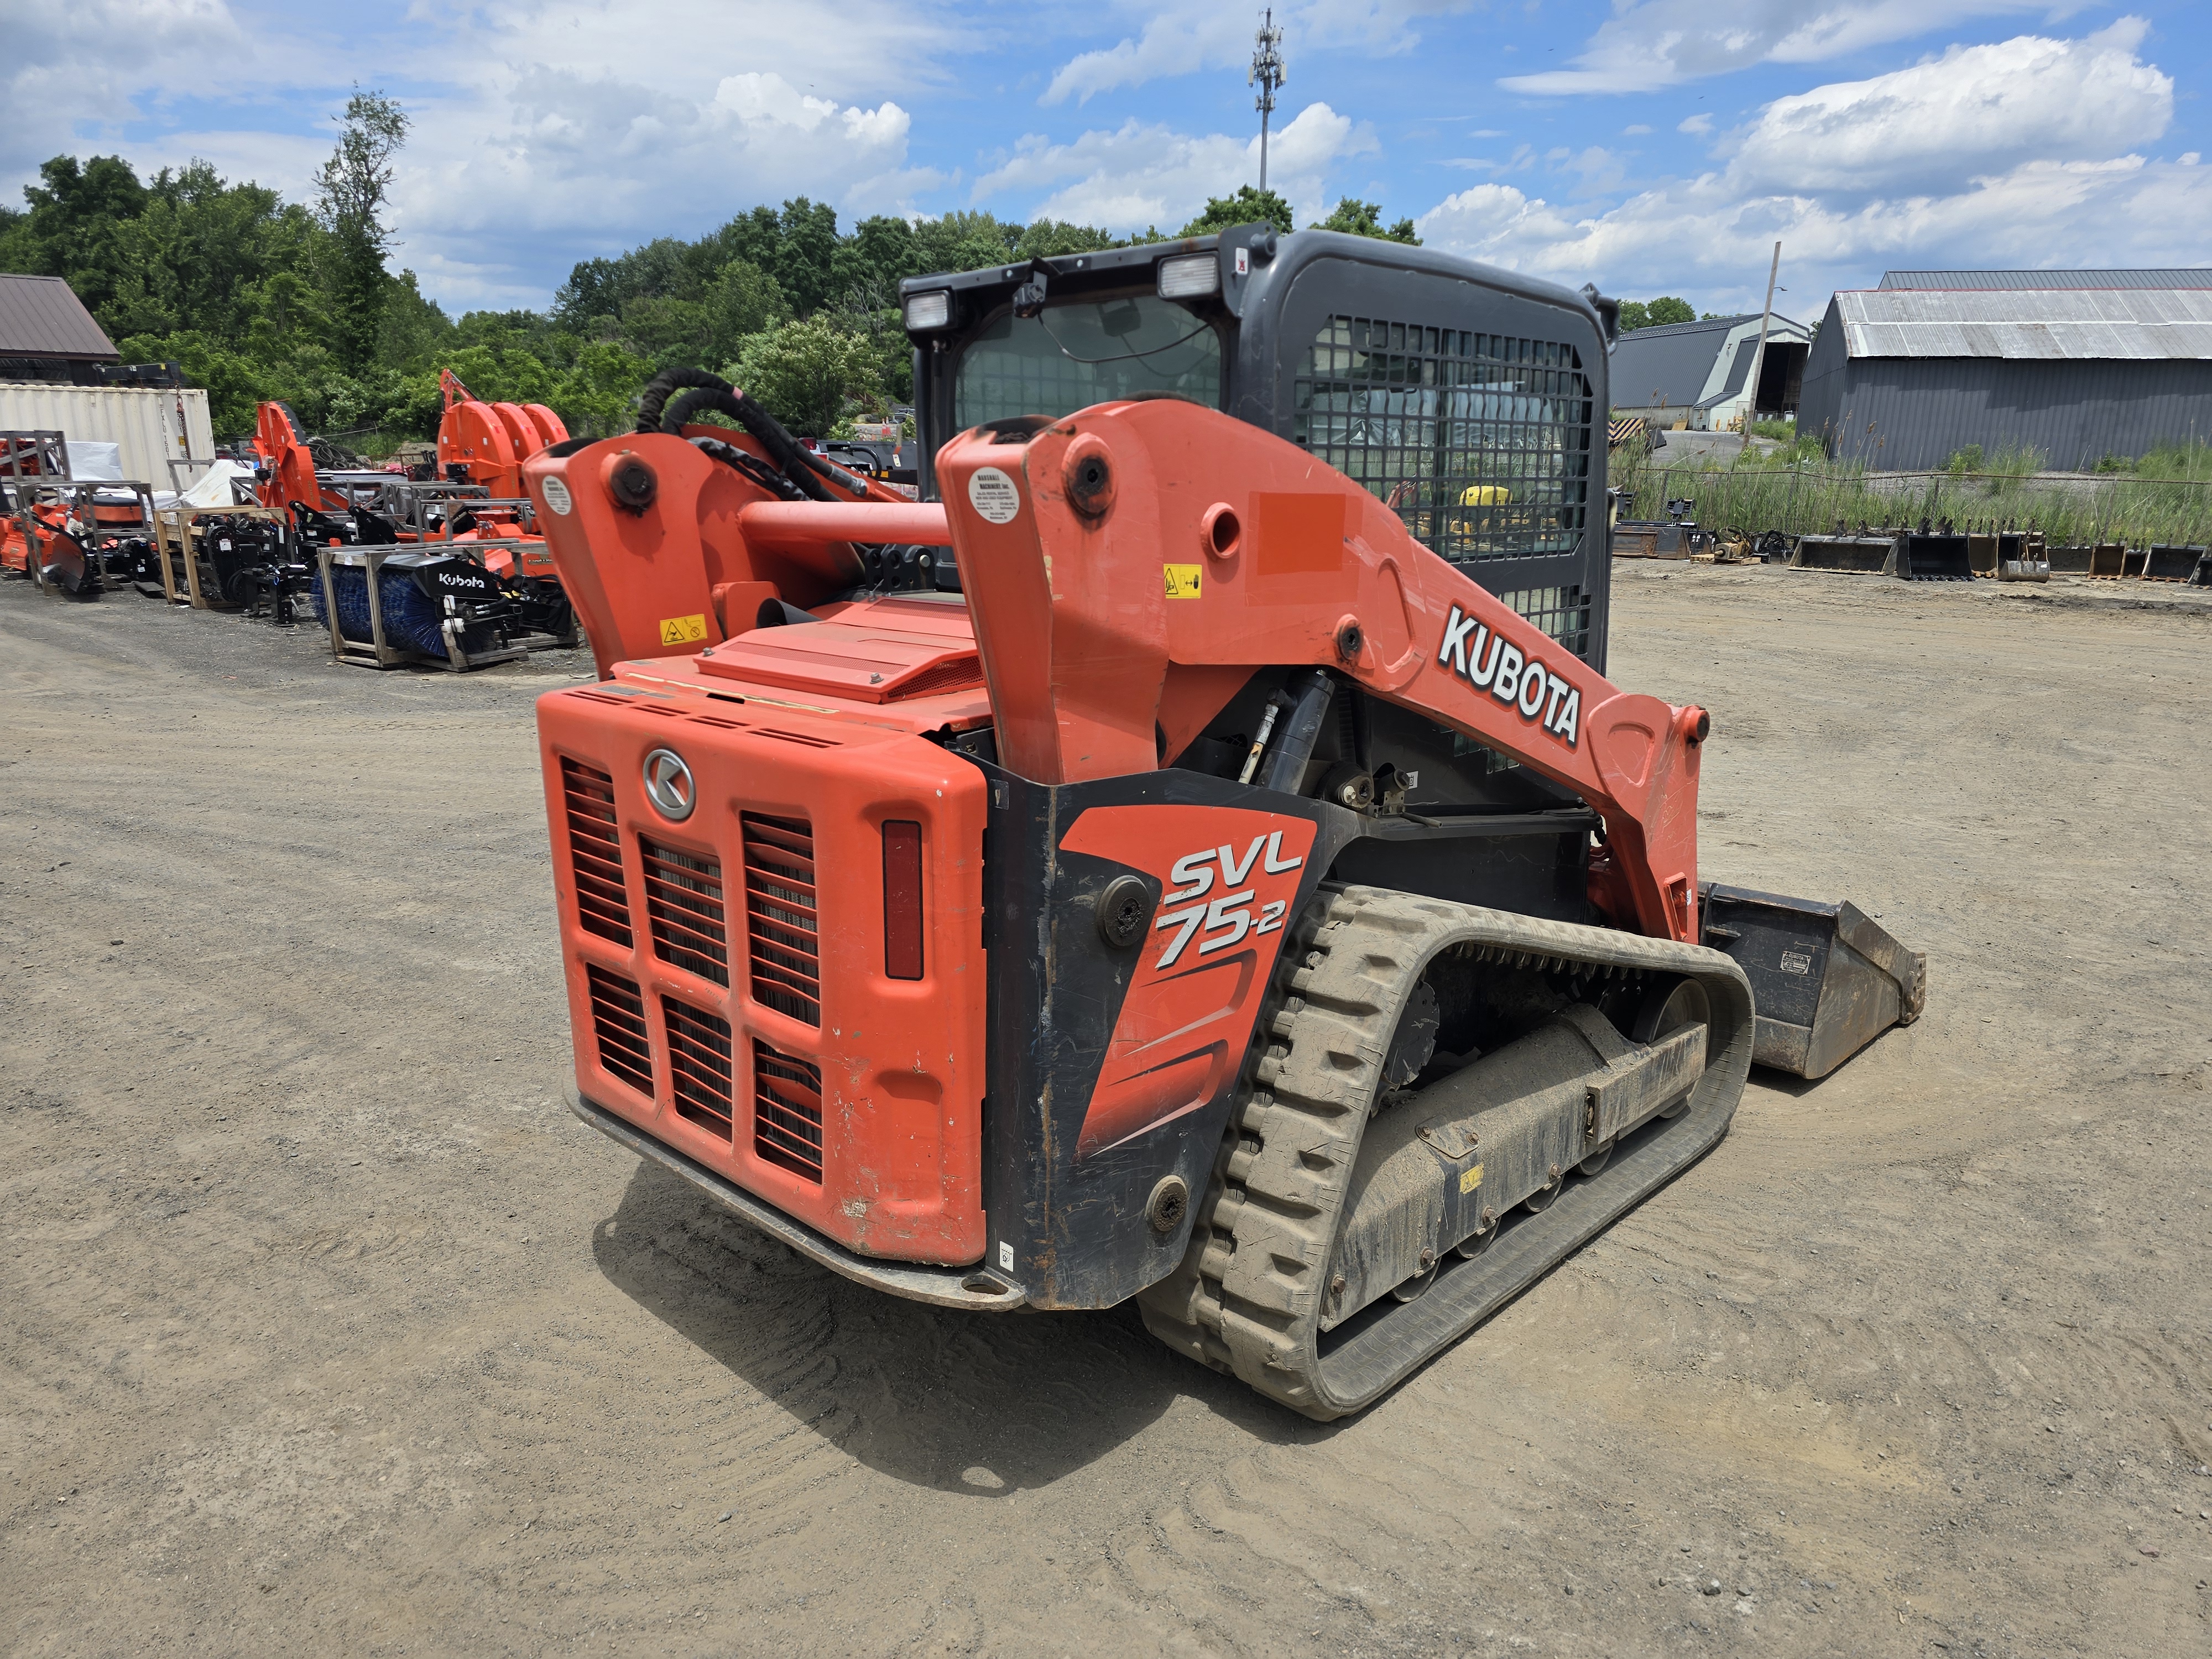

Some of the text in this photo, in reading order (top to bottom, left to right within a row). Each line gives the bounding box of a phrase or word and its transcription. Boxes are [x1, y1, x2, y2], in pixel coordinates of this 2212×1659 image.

[439, 573, 484, 588] Kubota
[1438, 606, 1580, 743] KUBOTA
[1164, 830, 1303, 906] SVL
[1154, 889, 1287, 970] 75-2
